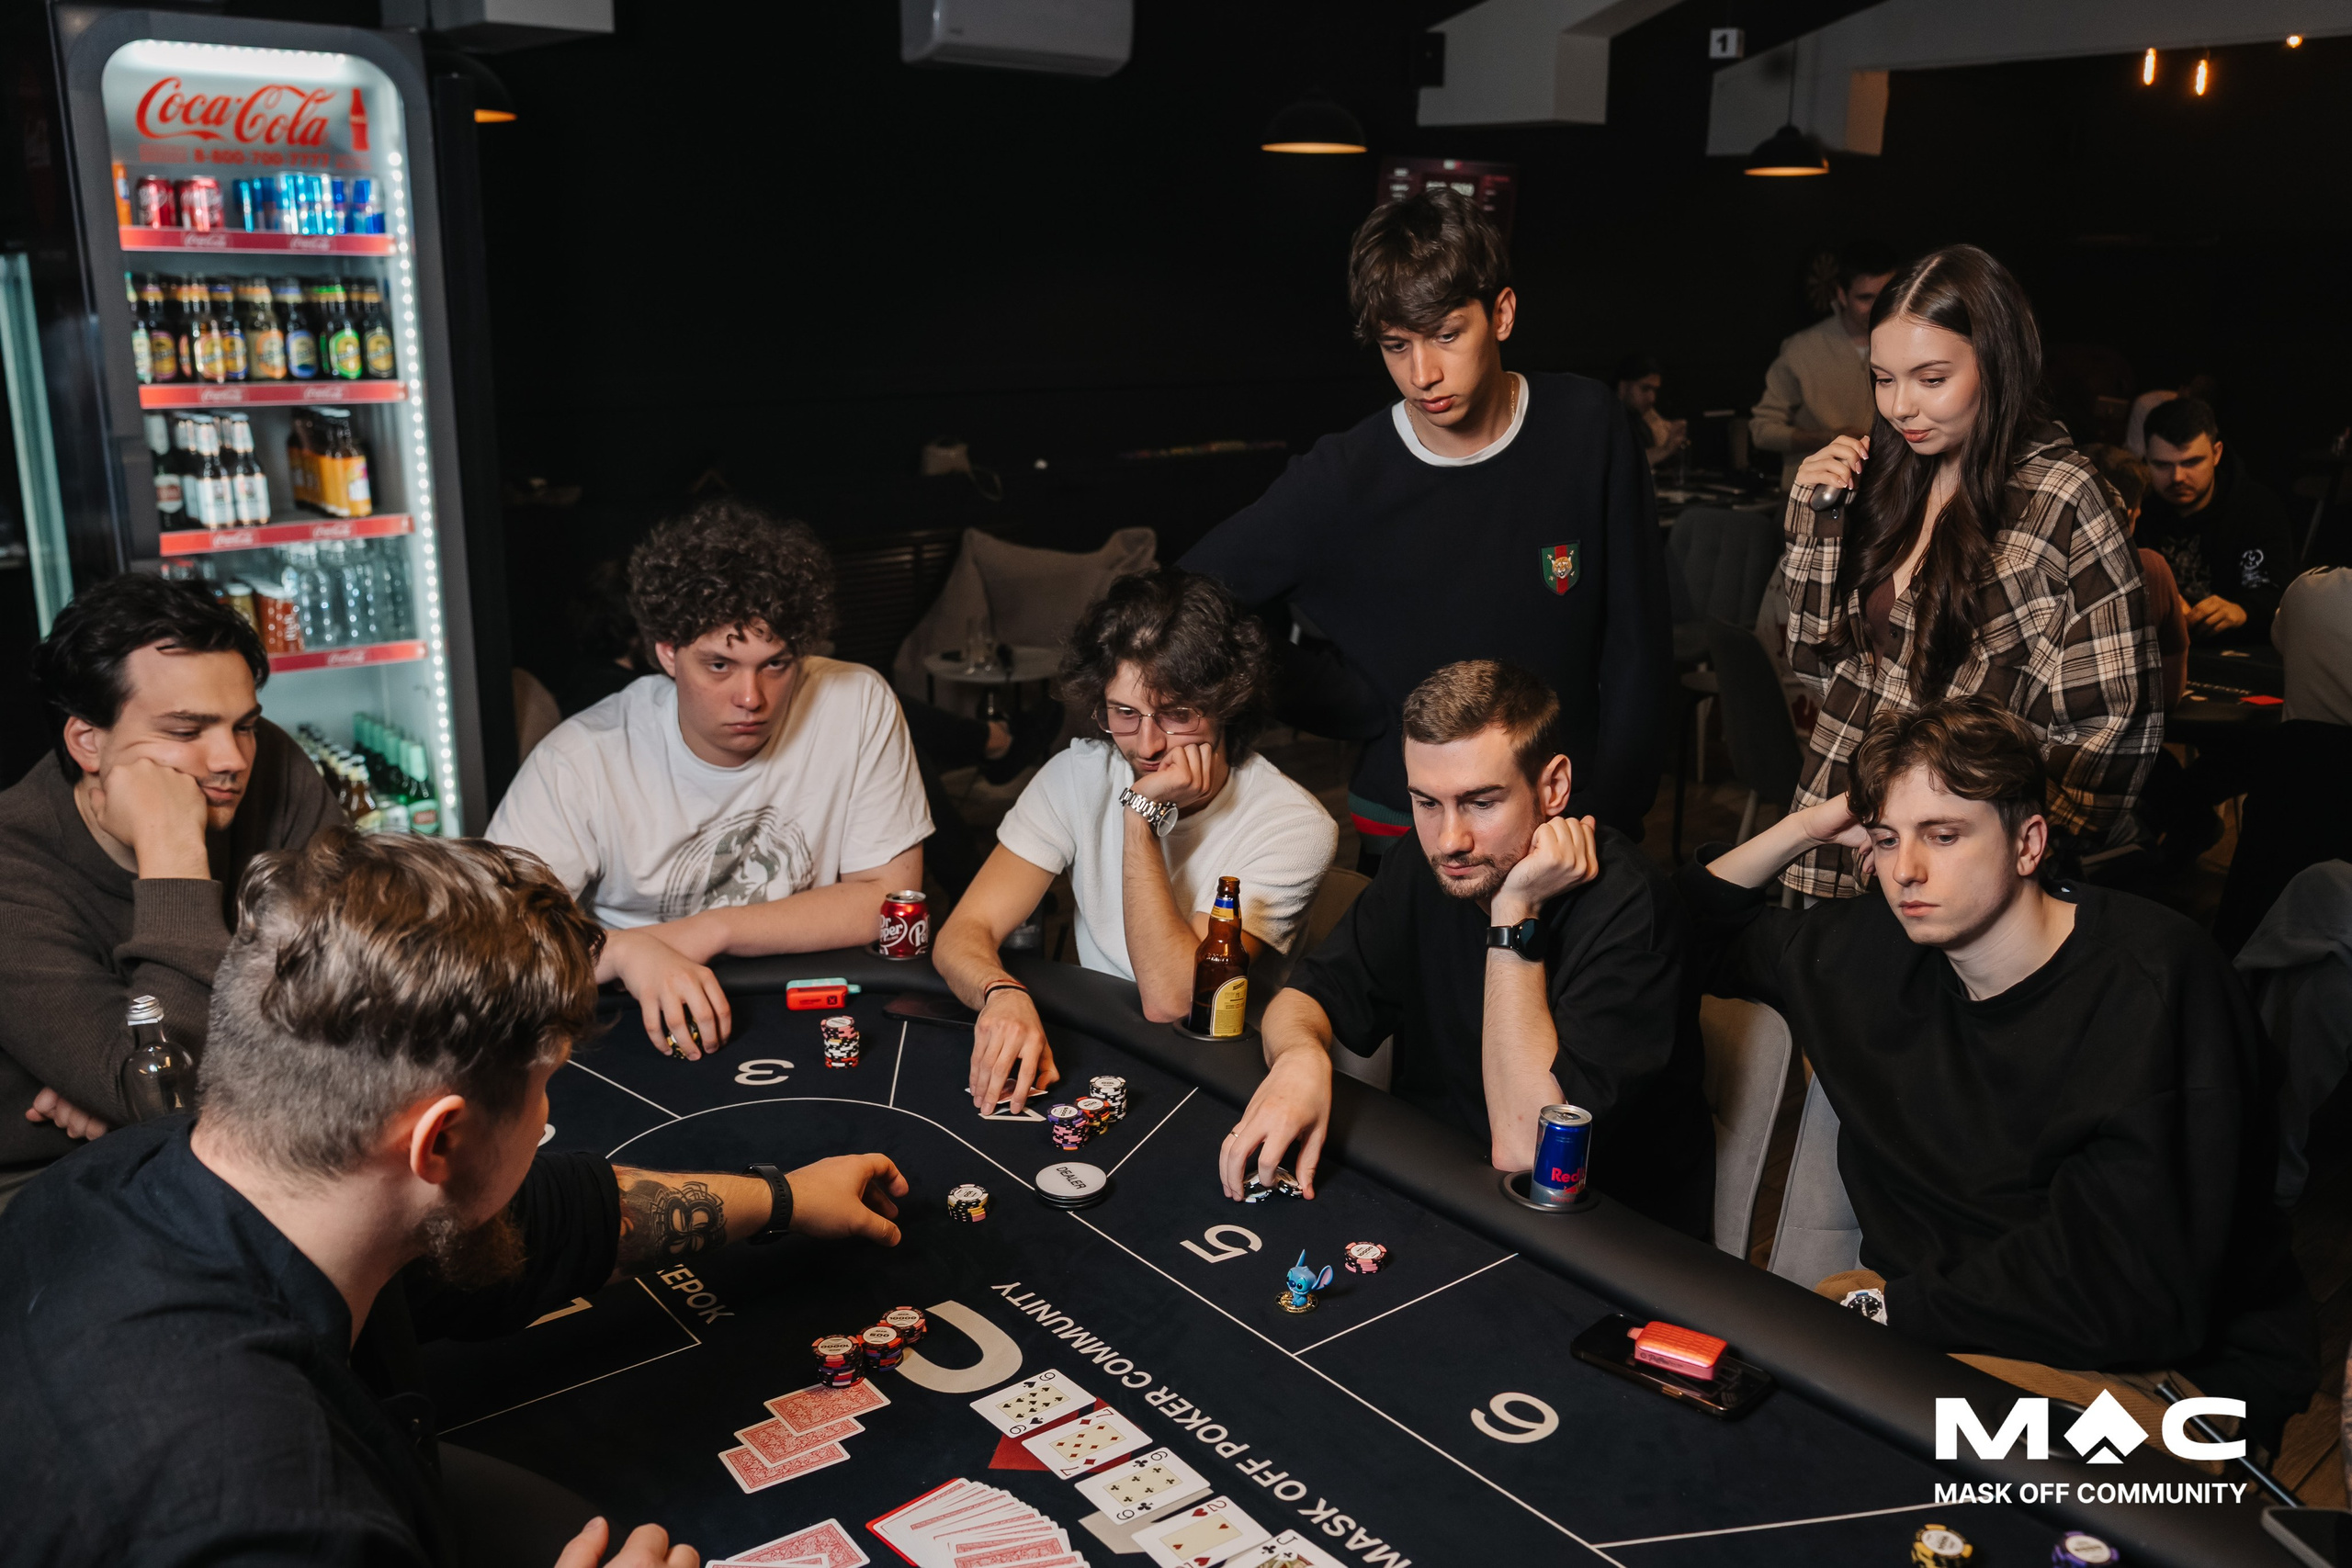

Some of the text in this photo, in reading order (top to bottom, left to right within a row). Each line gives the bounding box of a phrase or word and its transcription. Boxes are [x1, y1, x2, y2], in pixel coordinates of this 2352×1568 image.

[1715, 33, 1727, 52] 1
[136, 76, 335, 147] Coca-Cola
[734, 1059, 795, 1086] 3
[1057, 1166, 1087, 1190] DEALER
[1550, 1167, 1581, 1183] Red
[1179, 1224, 1263, 1264] 5
[1095, 1408, 1114, 1418] 7
[990, 1281, 1412, 1568] MASK OFF POKER COMMUNITY
[1059, 1465, 1080, 1477] 7
[1206, 1499, 1227, 1513] 2
